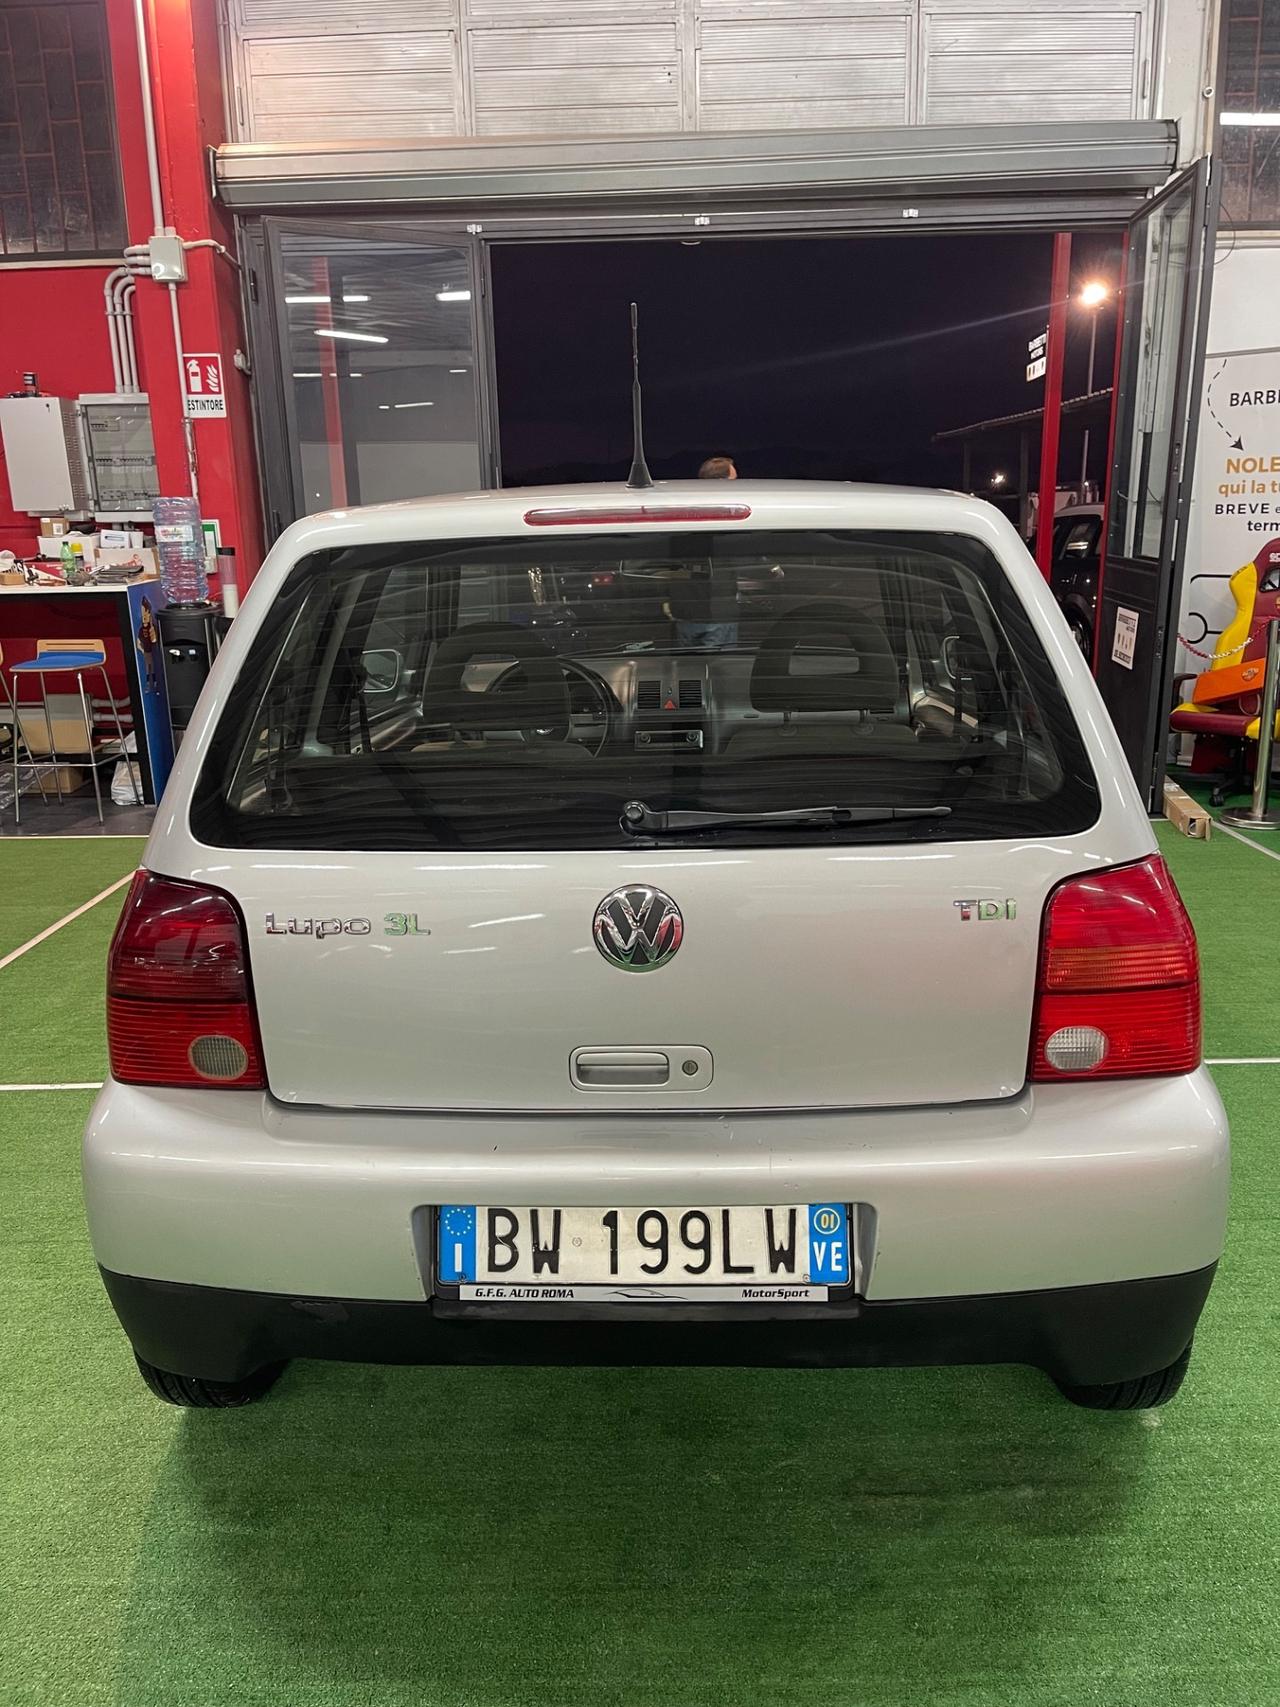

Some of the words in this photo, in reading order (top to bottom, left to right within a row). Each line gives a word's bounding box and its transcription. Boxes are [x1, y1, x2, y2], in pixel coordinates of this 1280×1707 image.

[187, 399, 223, 411] ESTINTORE
[1230, 389, 1280, 407] BARB
[1226, 456, 1280, 474] NOLE
[1219, 480, 1246, 497] qui
[1251, 480, 1266, 494] la
[1271, 480, 1280, 493] t
[1215, 503, 1270, 515] BREVE
[953, 898, 1016, 921] TDI
[265, 912, 371, 939] Lupo
[384, 912, 431, 936] 3L
[487, 1207, 562, 1275] BW
[812, 1241, 843, 1272] VE
[475, 1288, 506, 1298] G.F.G.
[509, 1288, 538, 1299] AUTO
[541, 1288, 574, 1299] ROMA
[741, 1288, 810, 1300] MotorSport
